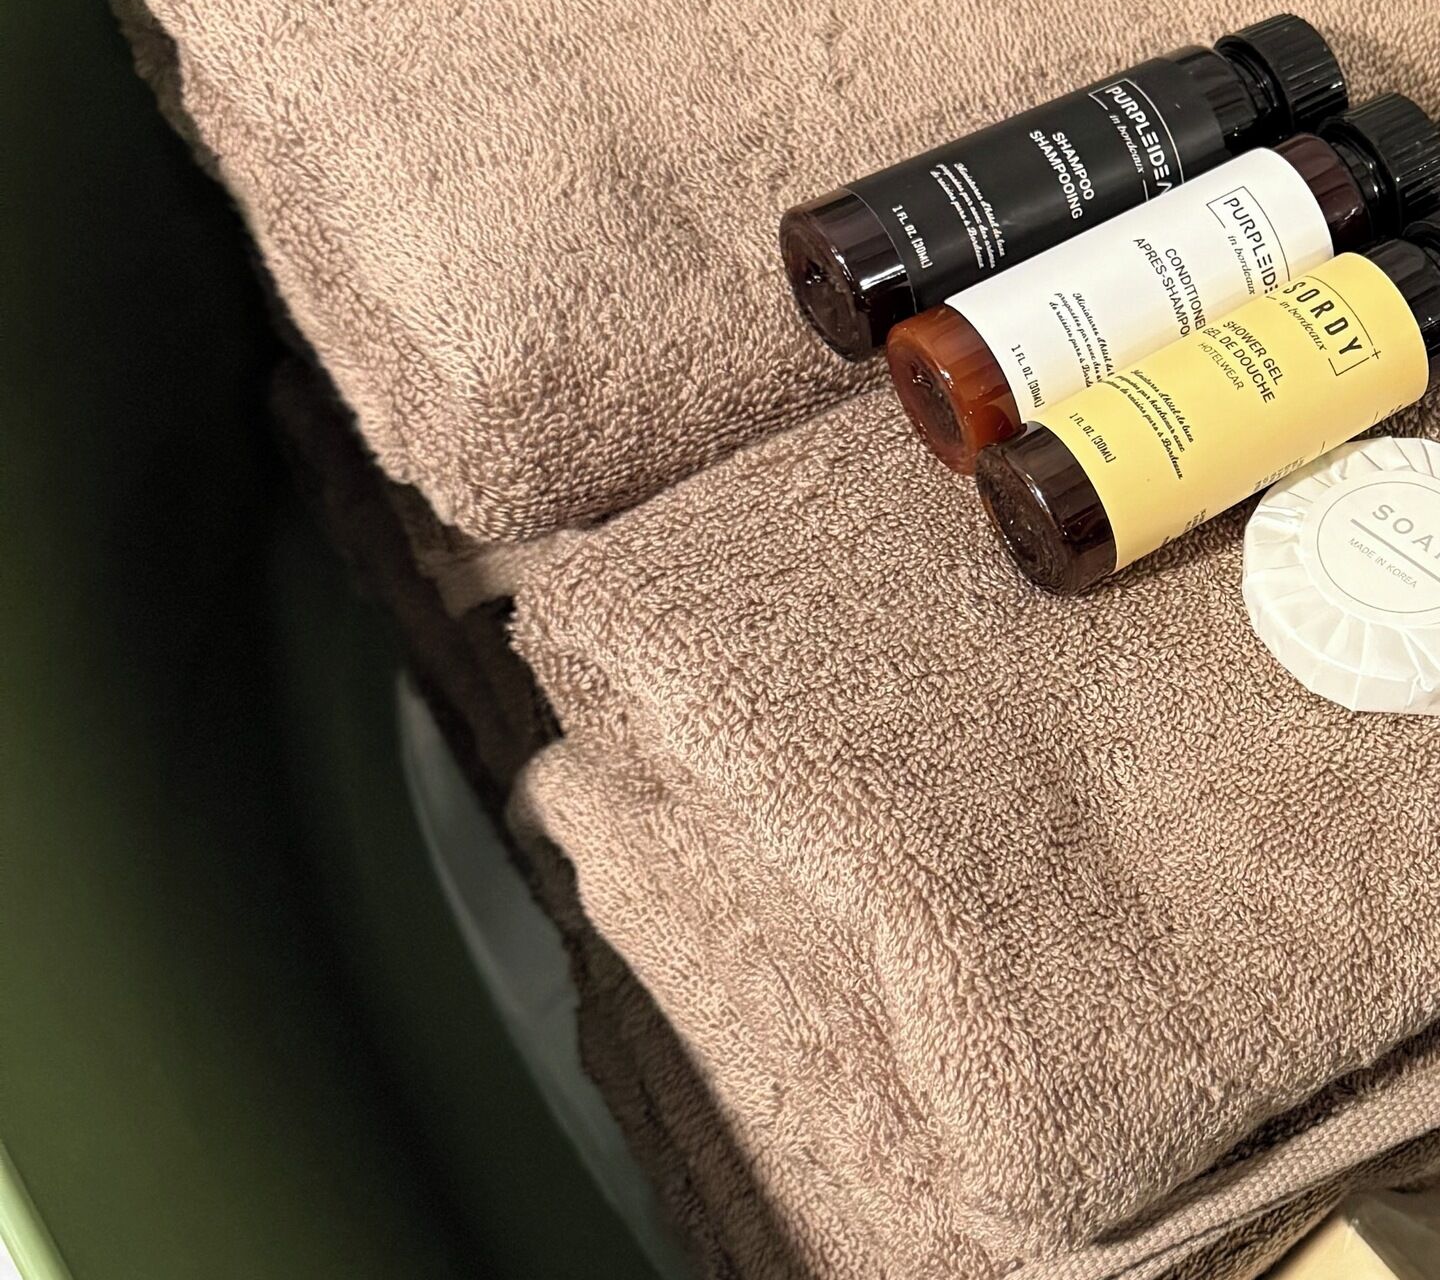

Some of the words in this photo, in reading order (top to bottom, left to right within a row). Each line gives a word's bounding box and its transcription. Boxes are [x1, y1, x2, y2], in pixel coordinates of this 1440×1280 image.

[1051, 131, 1096, 201] SHAMPOO
[1108, 113, 1121, 125] in
[1116, 124, 1145, 174] bordeaux
[1030, 129, 1083, 219] SHAMPOOING
[890, 203, 903, 213] 1
[896, 210, 908, 225] FL.
[903, 223, 917, 239] OZ.
[991, 228, 1002, 239] de
[1132, 237, 1190, 337] APRES-SHAMPO
[1165, 247, 1206, 330] CONDITIONE
[1226, 234, 1238, 246] in
[1233, 246, 1256, 295] bordeaux
[1048, 301, 1058, 310] de
[1067, 337, 1082, 357] purs
[1279, 300, 1291, 309] in
[1287, 308, 1327, 352] bordeaux
[1282, 282, 1362, 354] SORDY
[1010, 343, 1021, 352] 1
[1014, 351, 1025, 366] FL.
[1076, 328, 1089, 343] par
[1085, 342, 1096, 361] avec
[1197, 342, 1245, 390] HOTELWEAR
[1201, 326, 1222, 339] GEL
[1217, 335, 1238, 351] DE
[1231, 347, 1276, 403] DOUCHE
[1221, 319, 1268, 358] SHOWER
[1262, 356, 1283, 385] GEL
[1021, 365, 1033, 380] OZ.
[1081, 424, 1095, 437] OZ.
[1172, 434, 1185, 453] avec
[1174, 414, 1184, 425] de
[1160, 436, 1184, 480] Bordeaux
[1346, 536, 1375, 559] MADE
[1374, 555, 1387, 567] IN
[1385, 562, 1419, 589] KOREA
